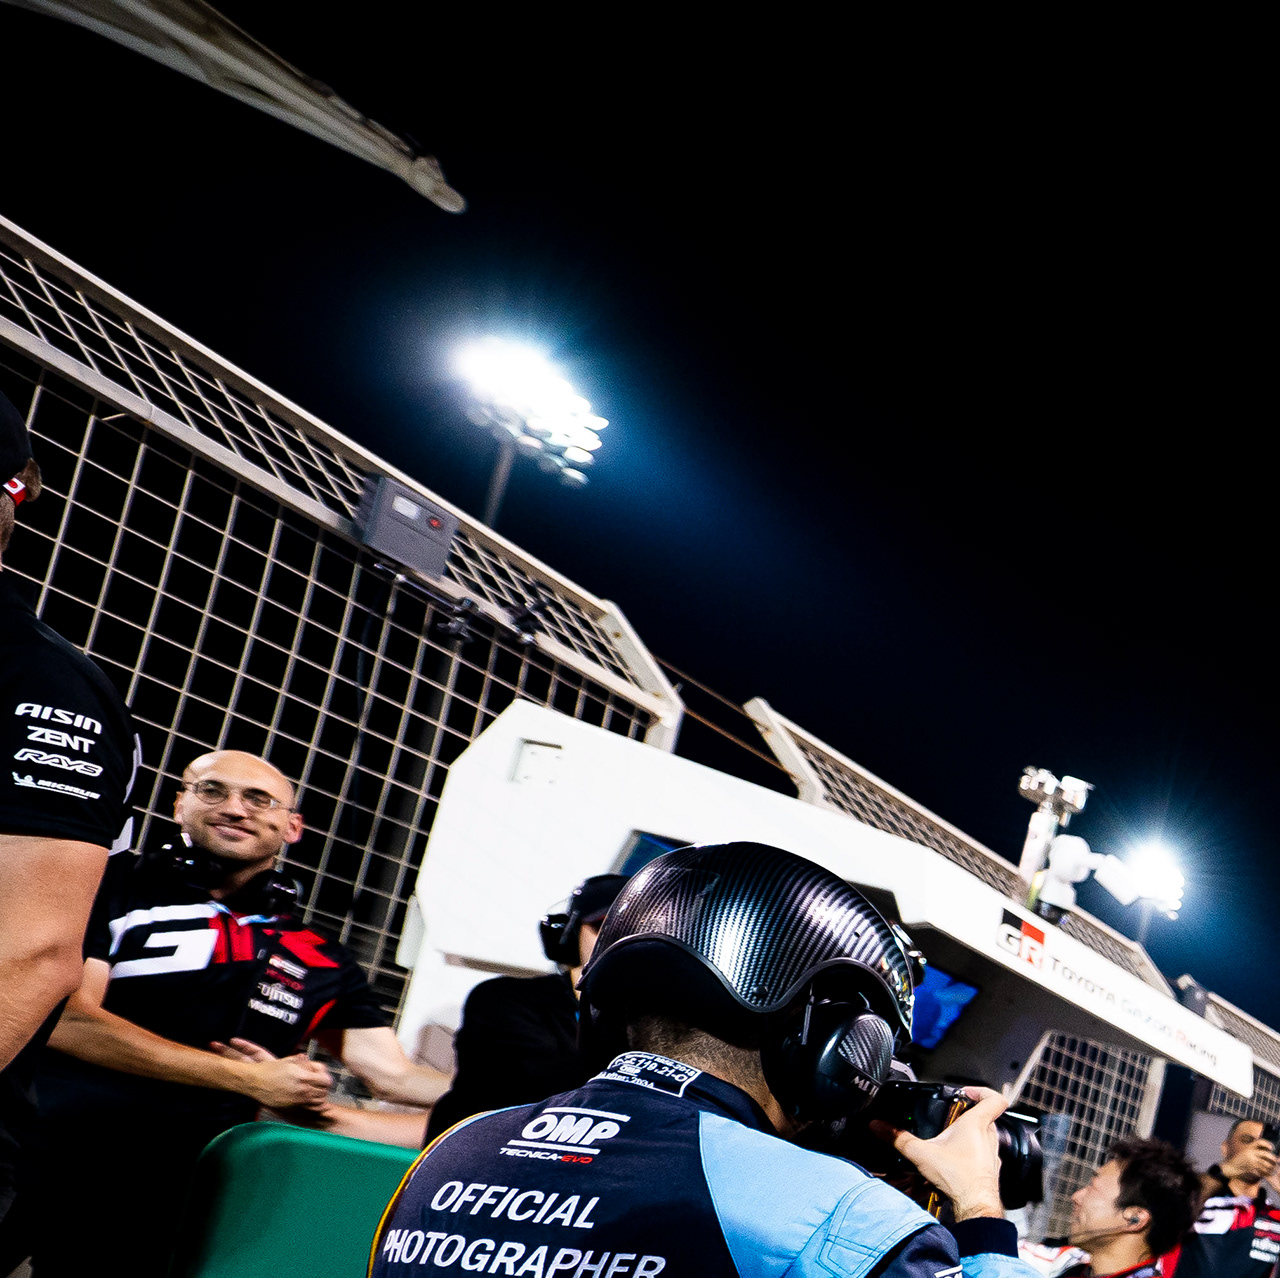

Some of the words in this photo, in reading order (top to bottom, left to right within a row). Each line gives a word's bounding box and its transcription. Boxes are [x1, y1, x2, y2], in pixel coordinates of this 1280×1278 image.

[15, 702, 103, 735] AISIN
[27, 725, 96, 754] ZENT
[14, 748, 104, 777] RAYS
[521, 1113, 622, 1145] OMP
[430, 1180, 600, 1229] OFFICIAL
